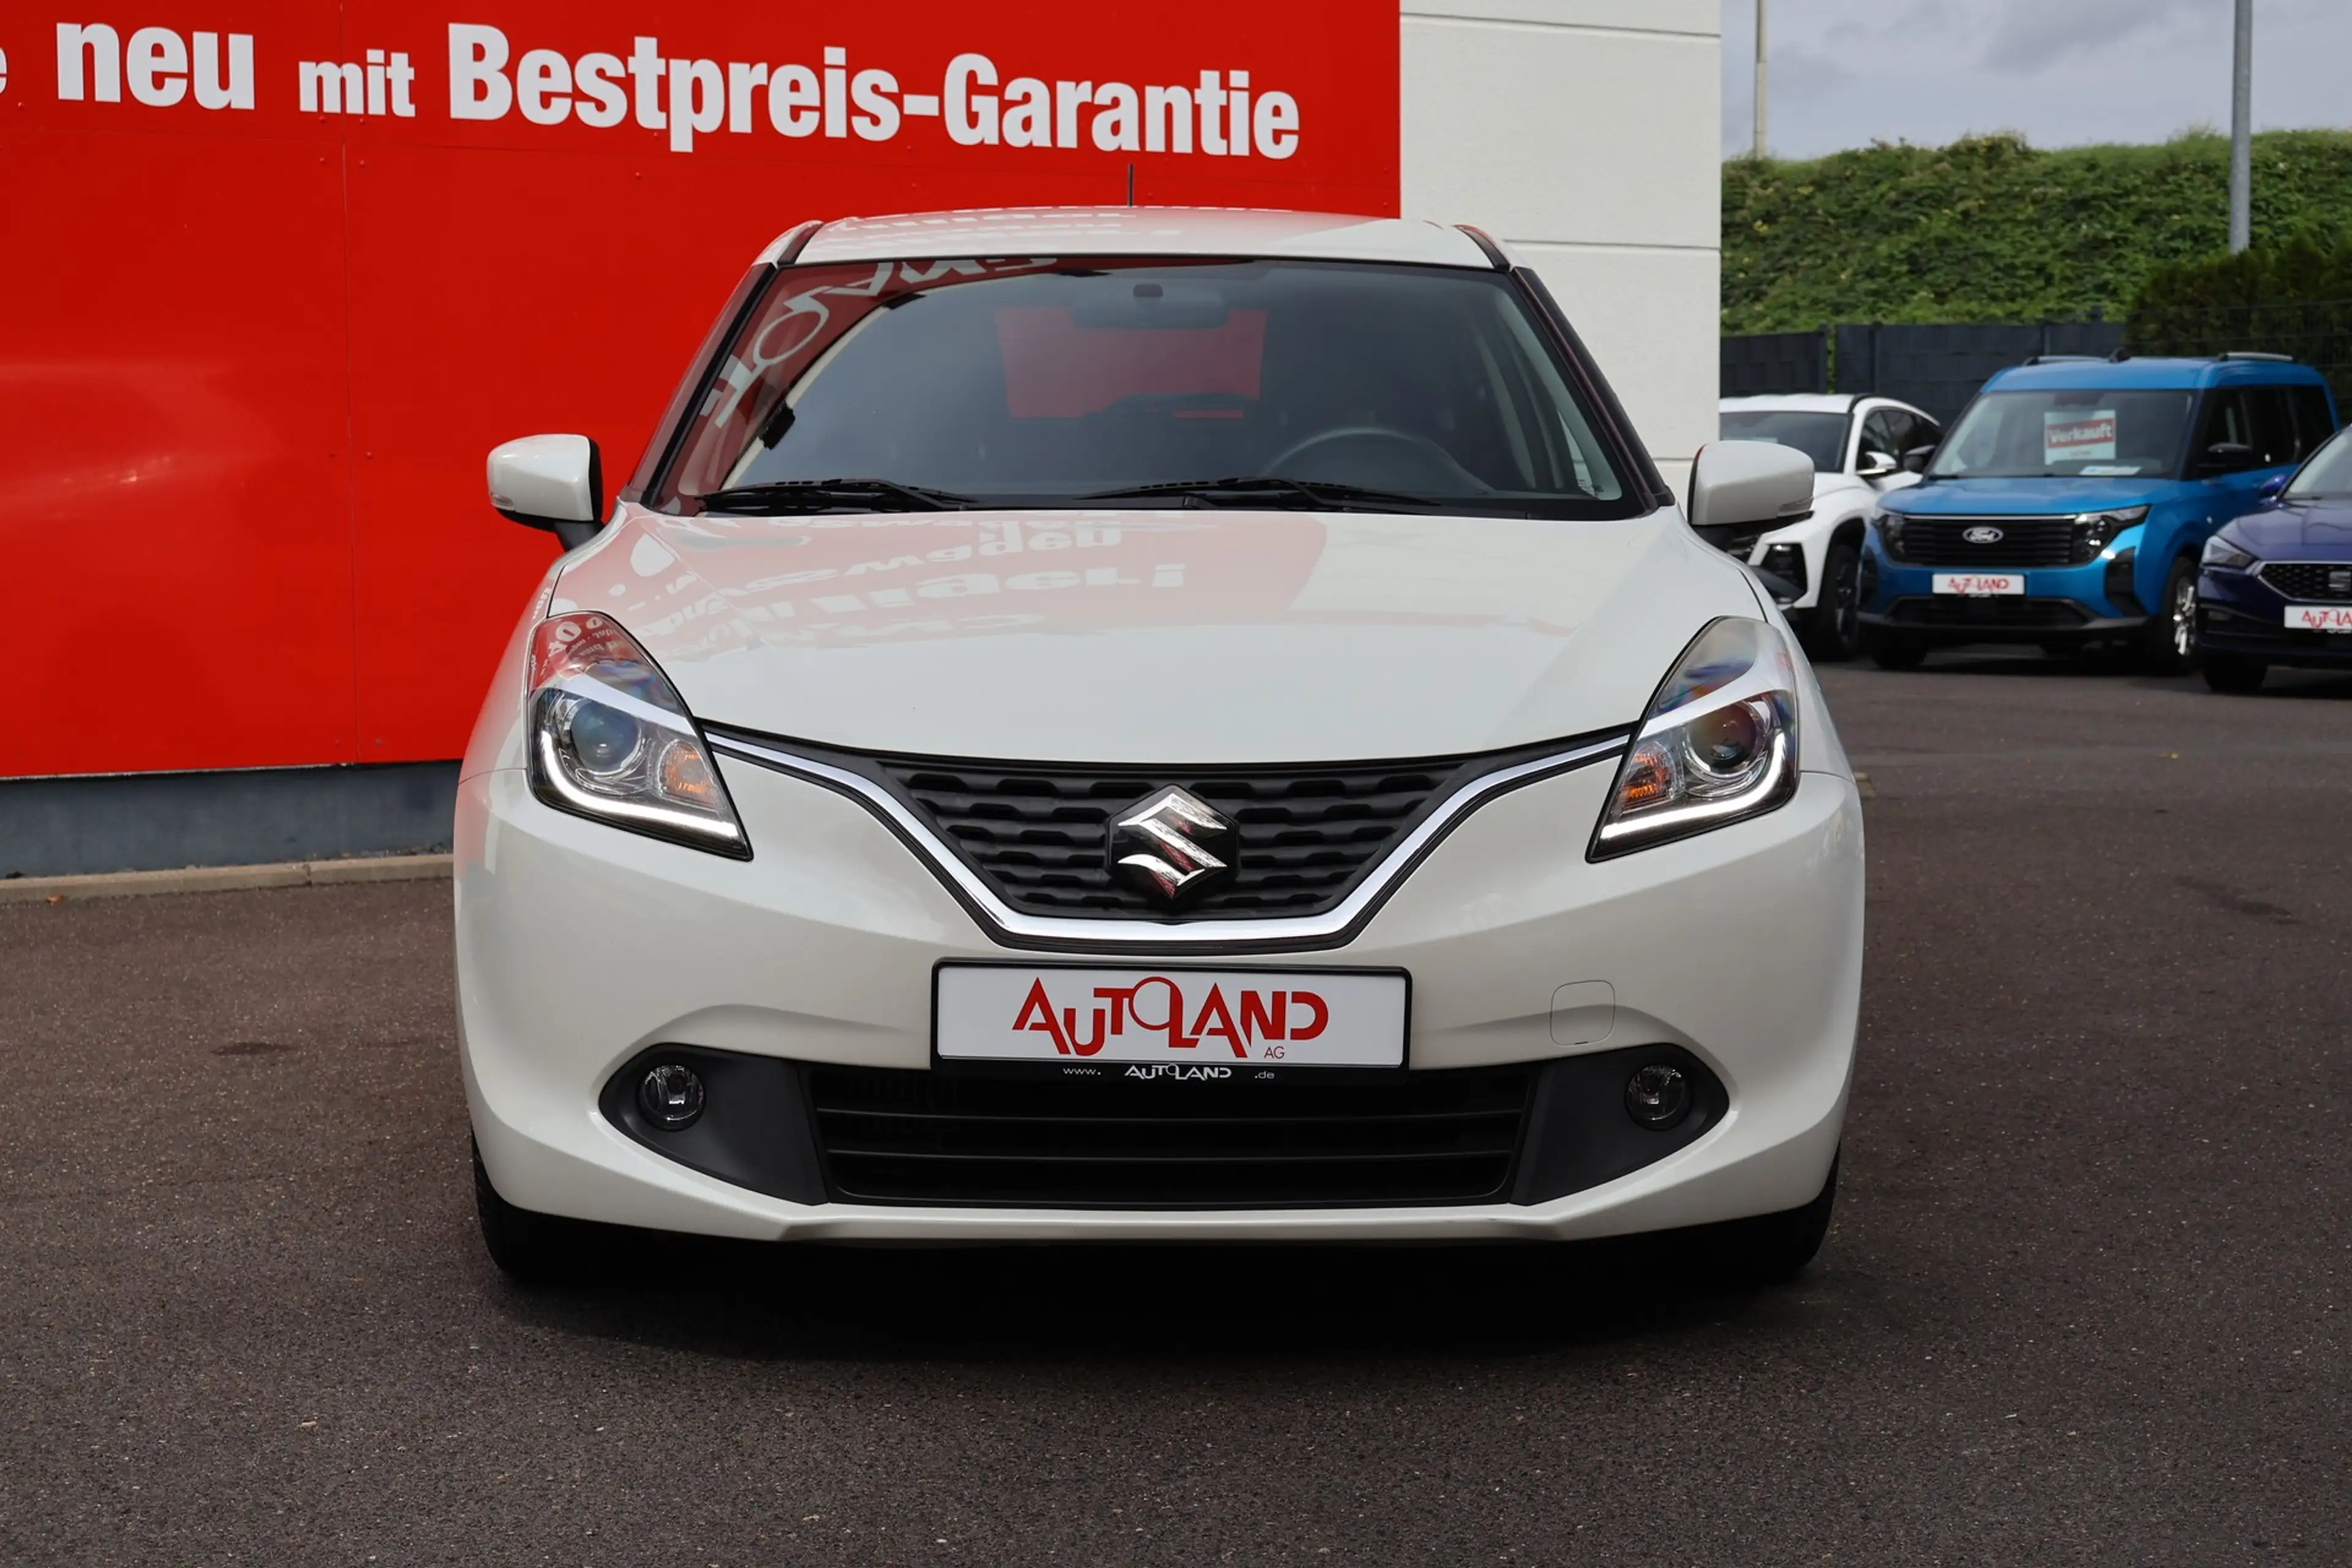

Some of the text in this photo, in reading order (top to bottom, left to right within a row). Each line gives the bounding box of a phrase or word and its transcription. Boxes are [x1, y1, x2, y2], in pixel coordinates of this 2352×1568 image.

[56, 23, 255, 110] neu
[299, 49, 416, 117] mit
[448, 23, 1299, 159] Bestpreis-Garantie
[1012, 976, 1329, 1058] AUTOLAND
[1125, 1064, 1232, 1080] AUTOLAND
[1254, 1070, 1275, 1079] .de
[1264, 1046, 1285, 1060] AG
